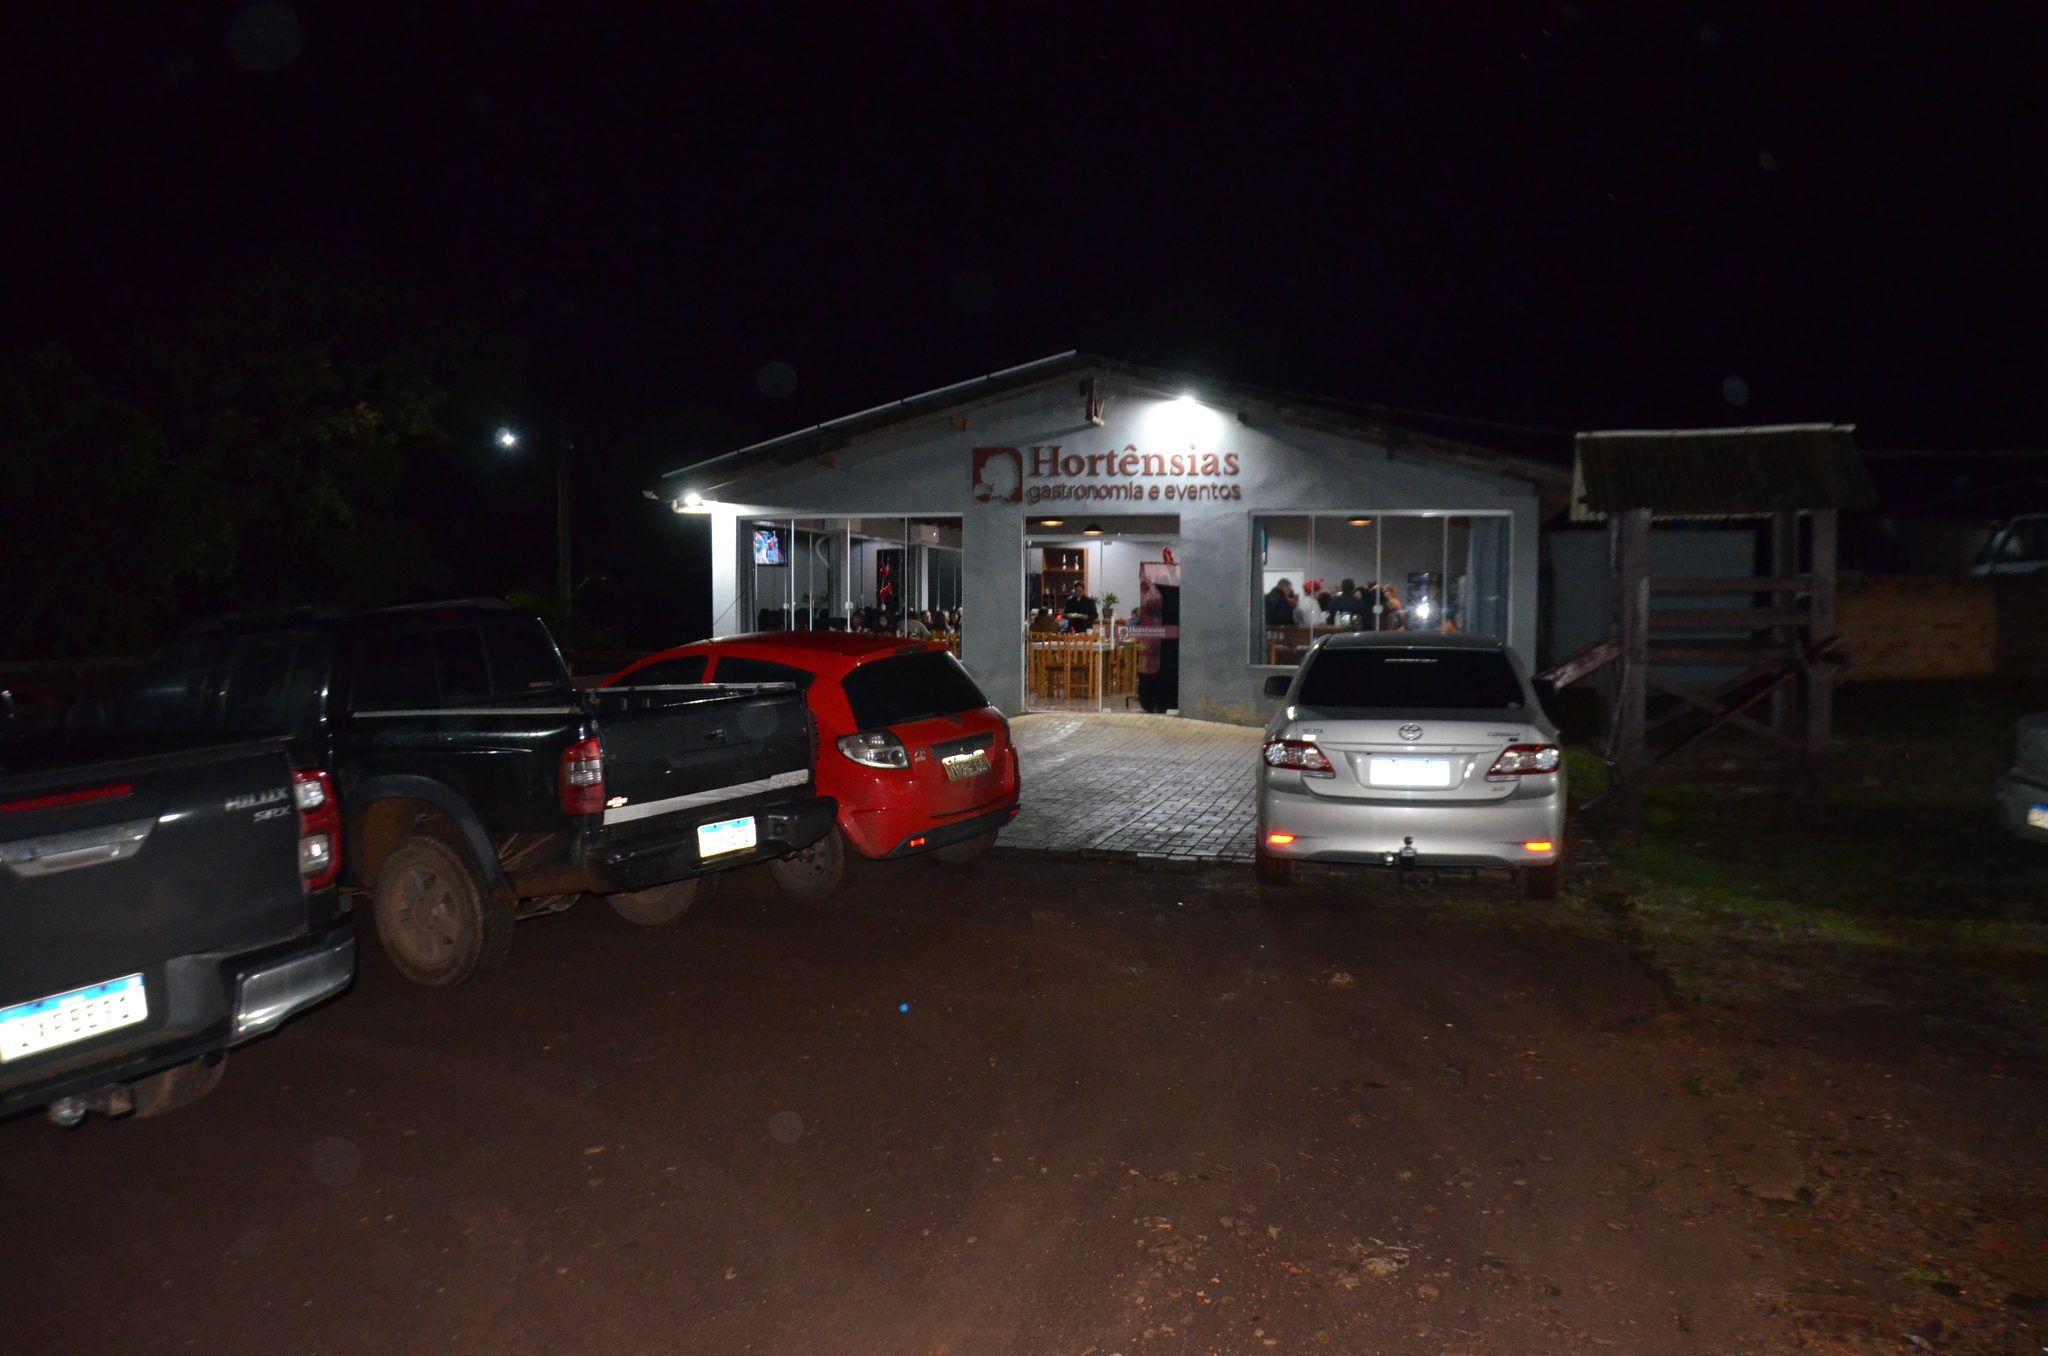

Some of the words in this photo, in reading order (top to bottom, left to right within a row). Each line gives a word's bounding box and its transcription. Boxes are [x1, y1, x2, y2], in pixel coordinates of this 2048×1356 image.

[1027, 443, 1240, 478] Hortênsias
[1148, 484, 1160, 501] e
[1164, 481, 1242, 501] eventos
